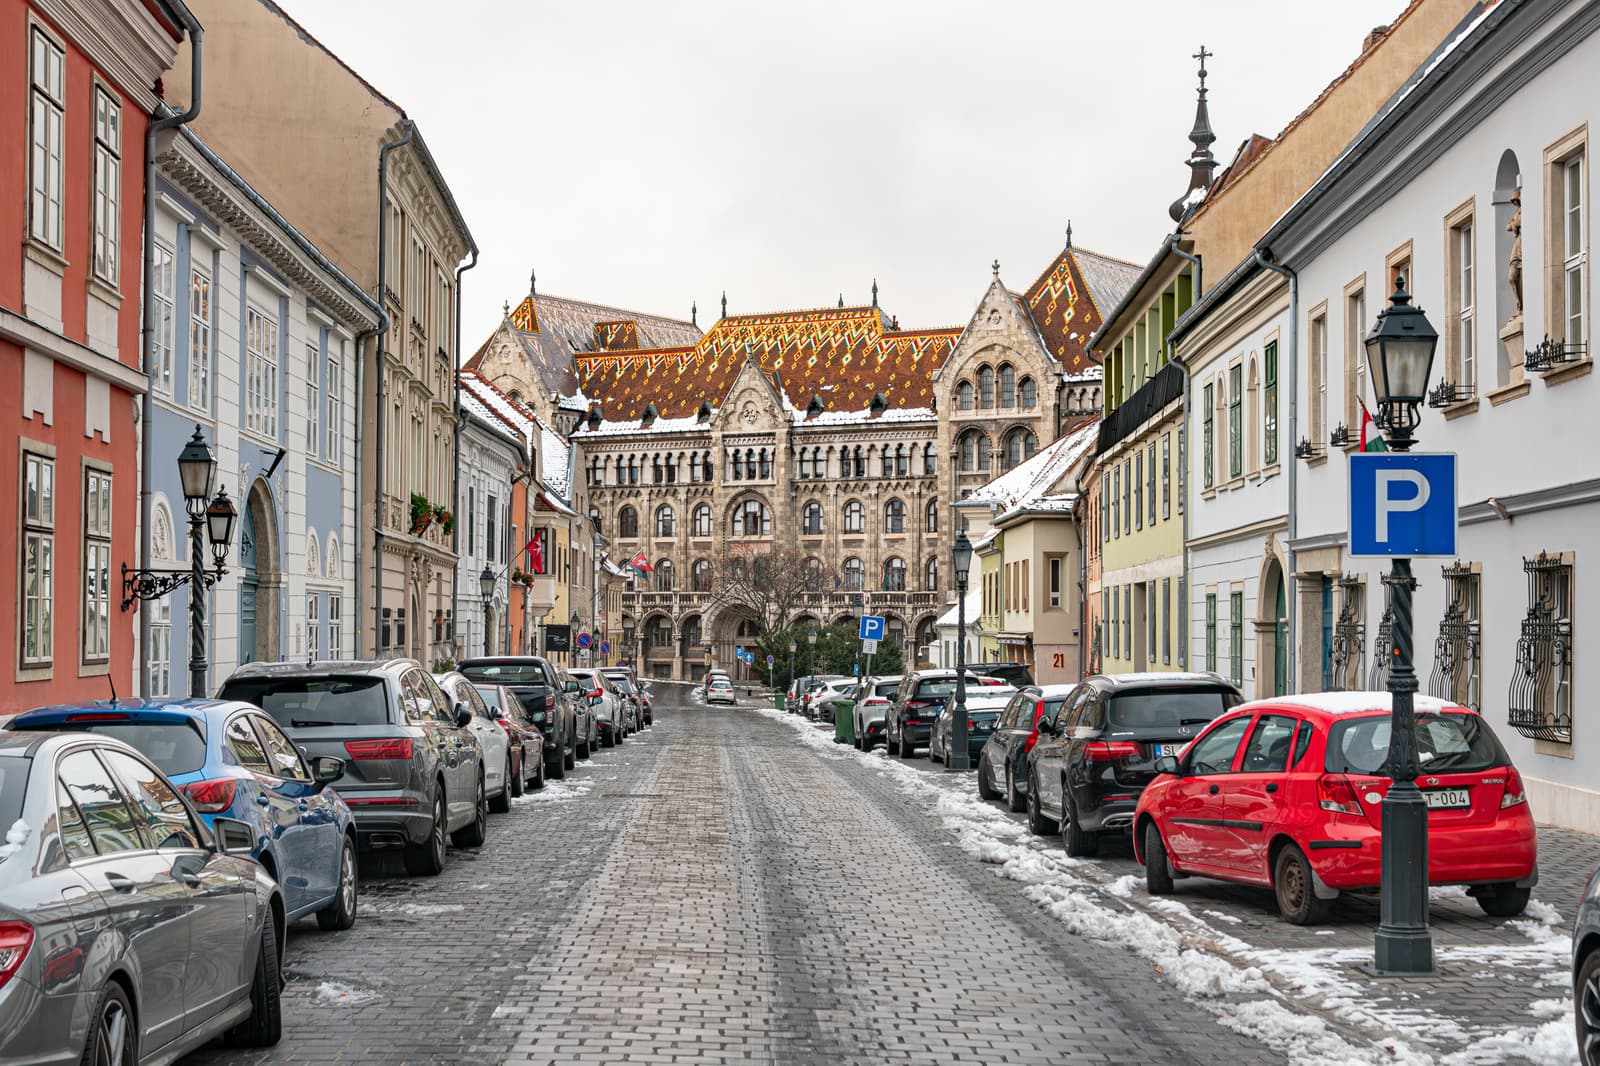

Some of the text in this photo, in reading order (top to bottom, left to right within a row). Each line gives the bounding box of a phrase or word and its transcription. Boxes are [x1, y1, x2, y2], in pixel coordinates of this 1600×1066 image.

[1375, 468, 1431, 543] P
[865, 619, 879, 637] P
[1053, 652, 1065, 668] 21
[1425, 791, 1466, 806] T-004
